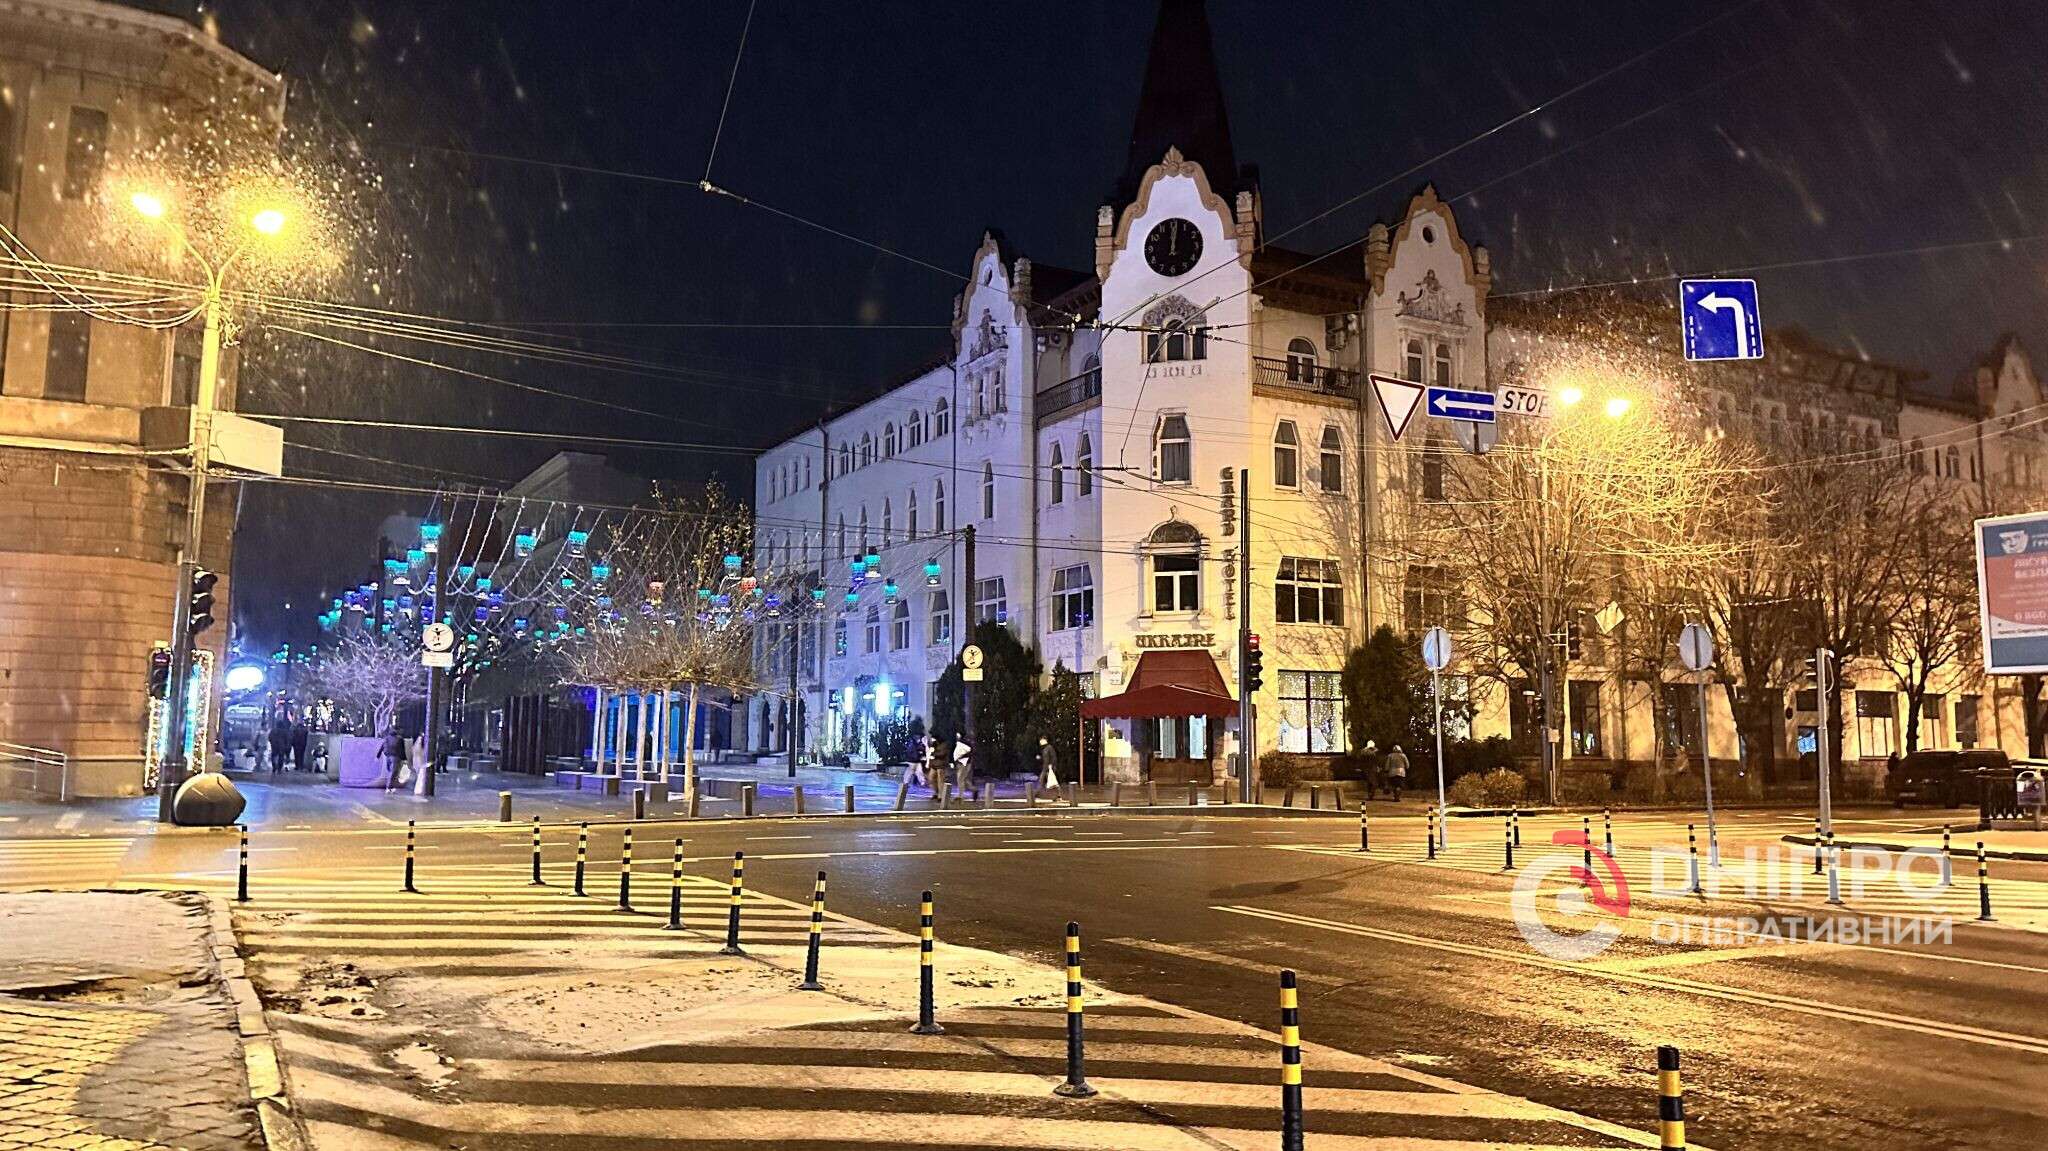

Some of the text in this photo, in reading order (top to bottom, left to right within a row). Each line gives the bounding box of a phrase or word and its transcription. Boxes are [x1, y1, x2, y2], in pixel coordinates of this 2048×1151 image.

[1220, 466, 1237, 621] GRAND HOTEL
[1135, 632, 1217, 649] UKRAINE
